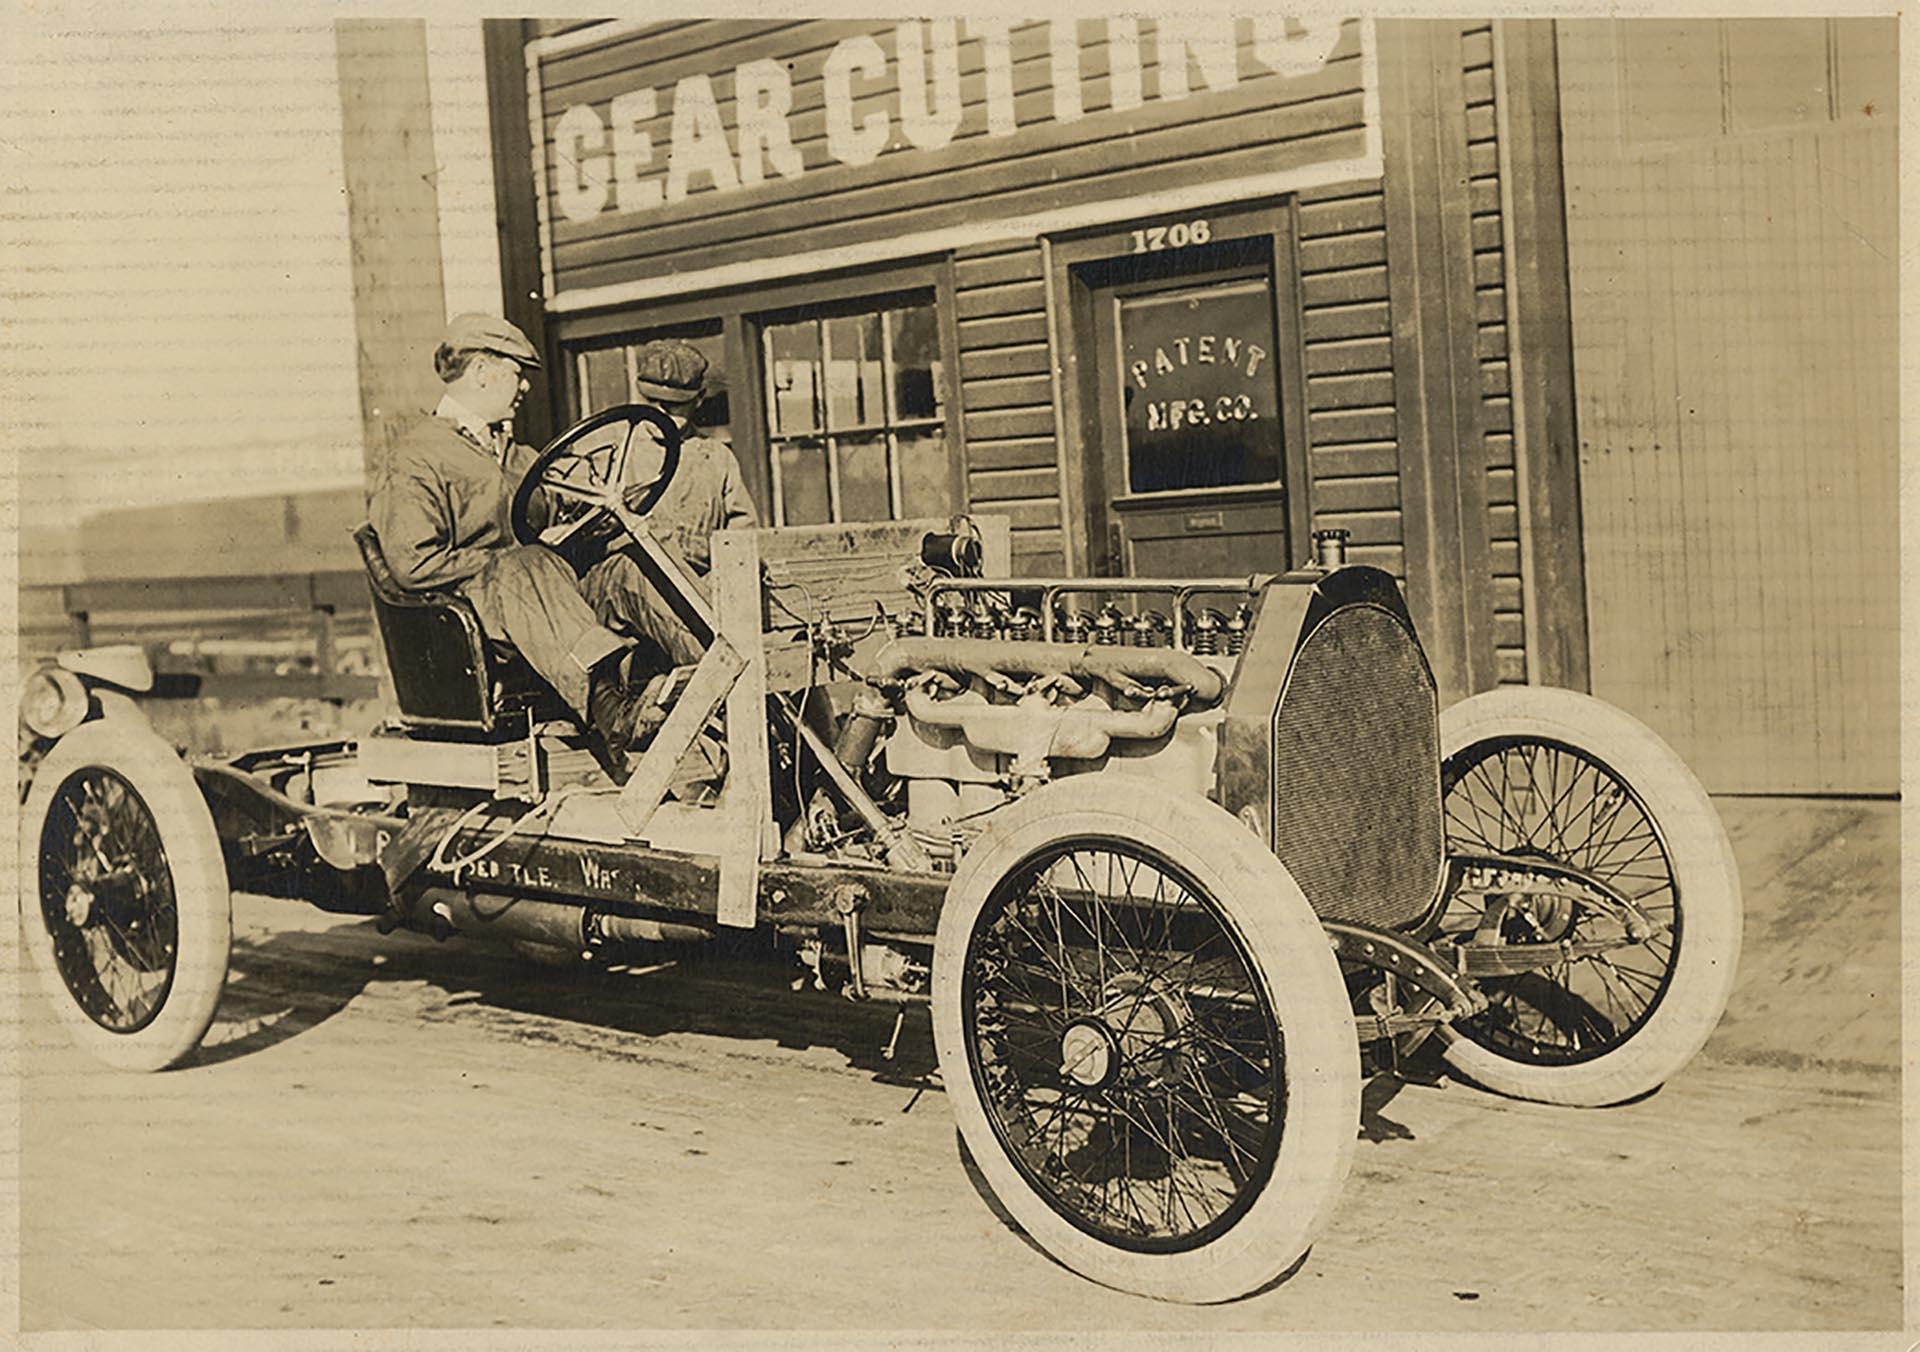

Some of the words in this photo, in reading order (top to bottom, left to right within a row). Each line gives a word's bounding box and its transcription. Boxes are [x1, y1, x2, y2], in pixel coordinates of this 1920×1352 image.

[554, 57, 804, 223] GEAR
[1131, 219, 1211, 254] 1706
[1132, 336, 1266, 389] PATENT
[1147, 398, 1211, 431] MFG.
[1216, 394, 1258, 421] CO.
